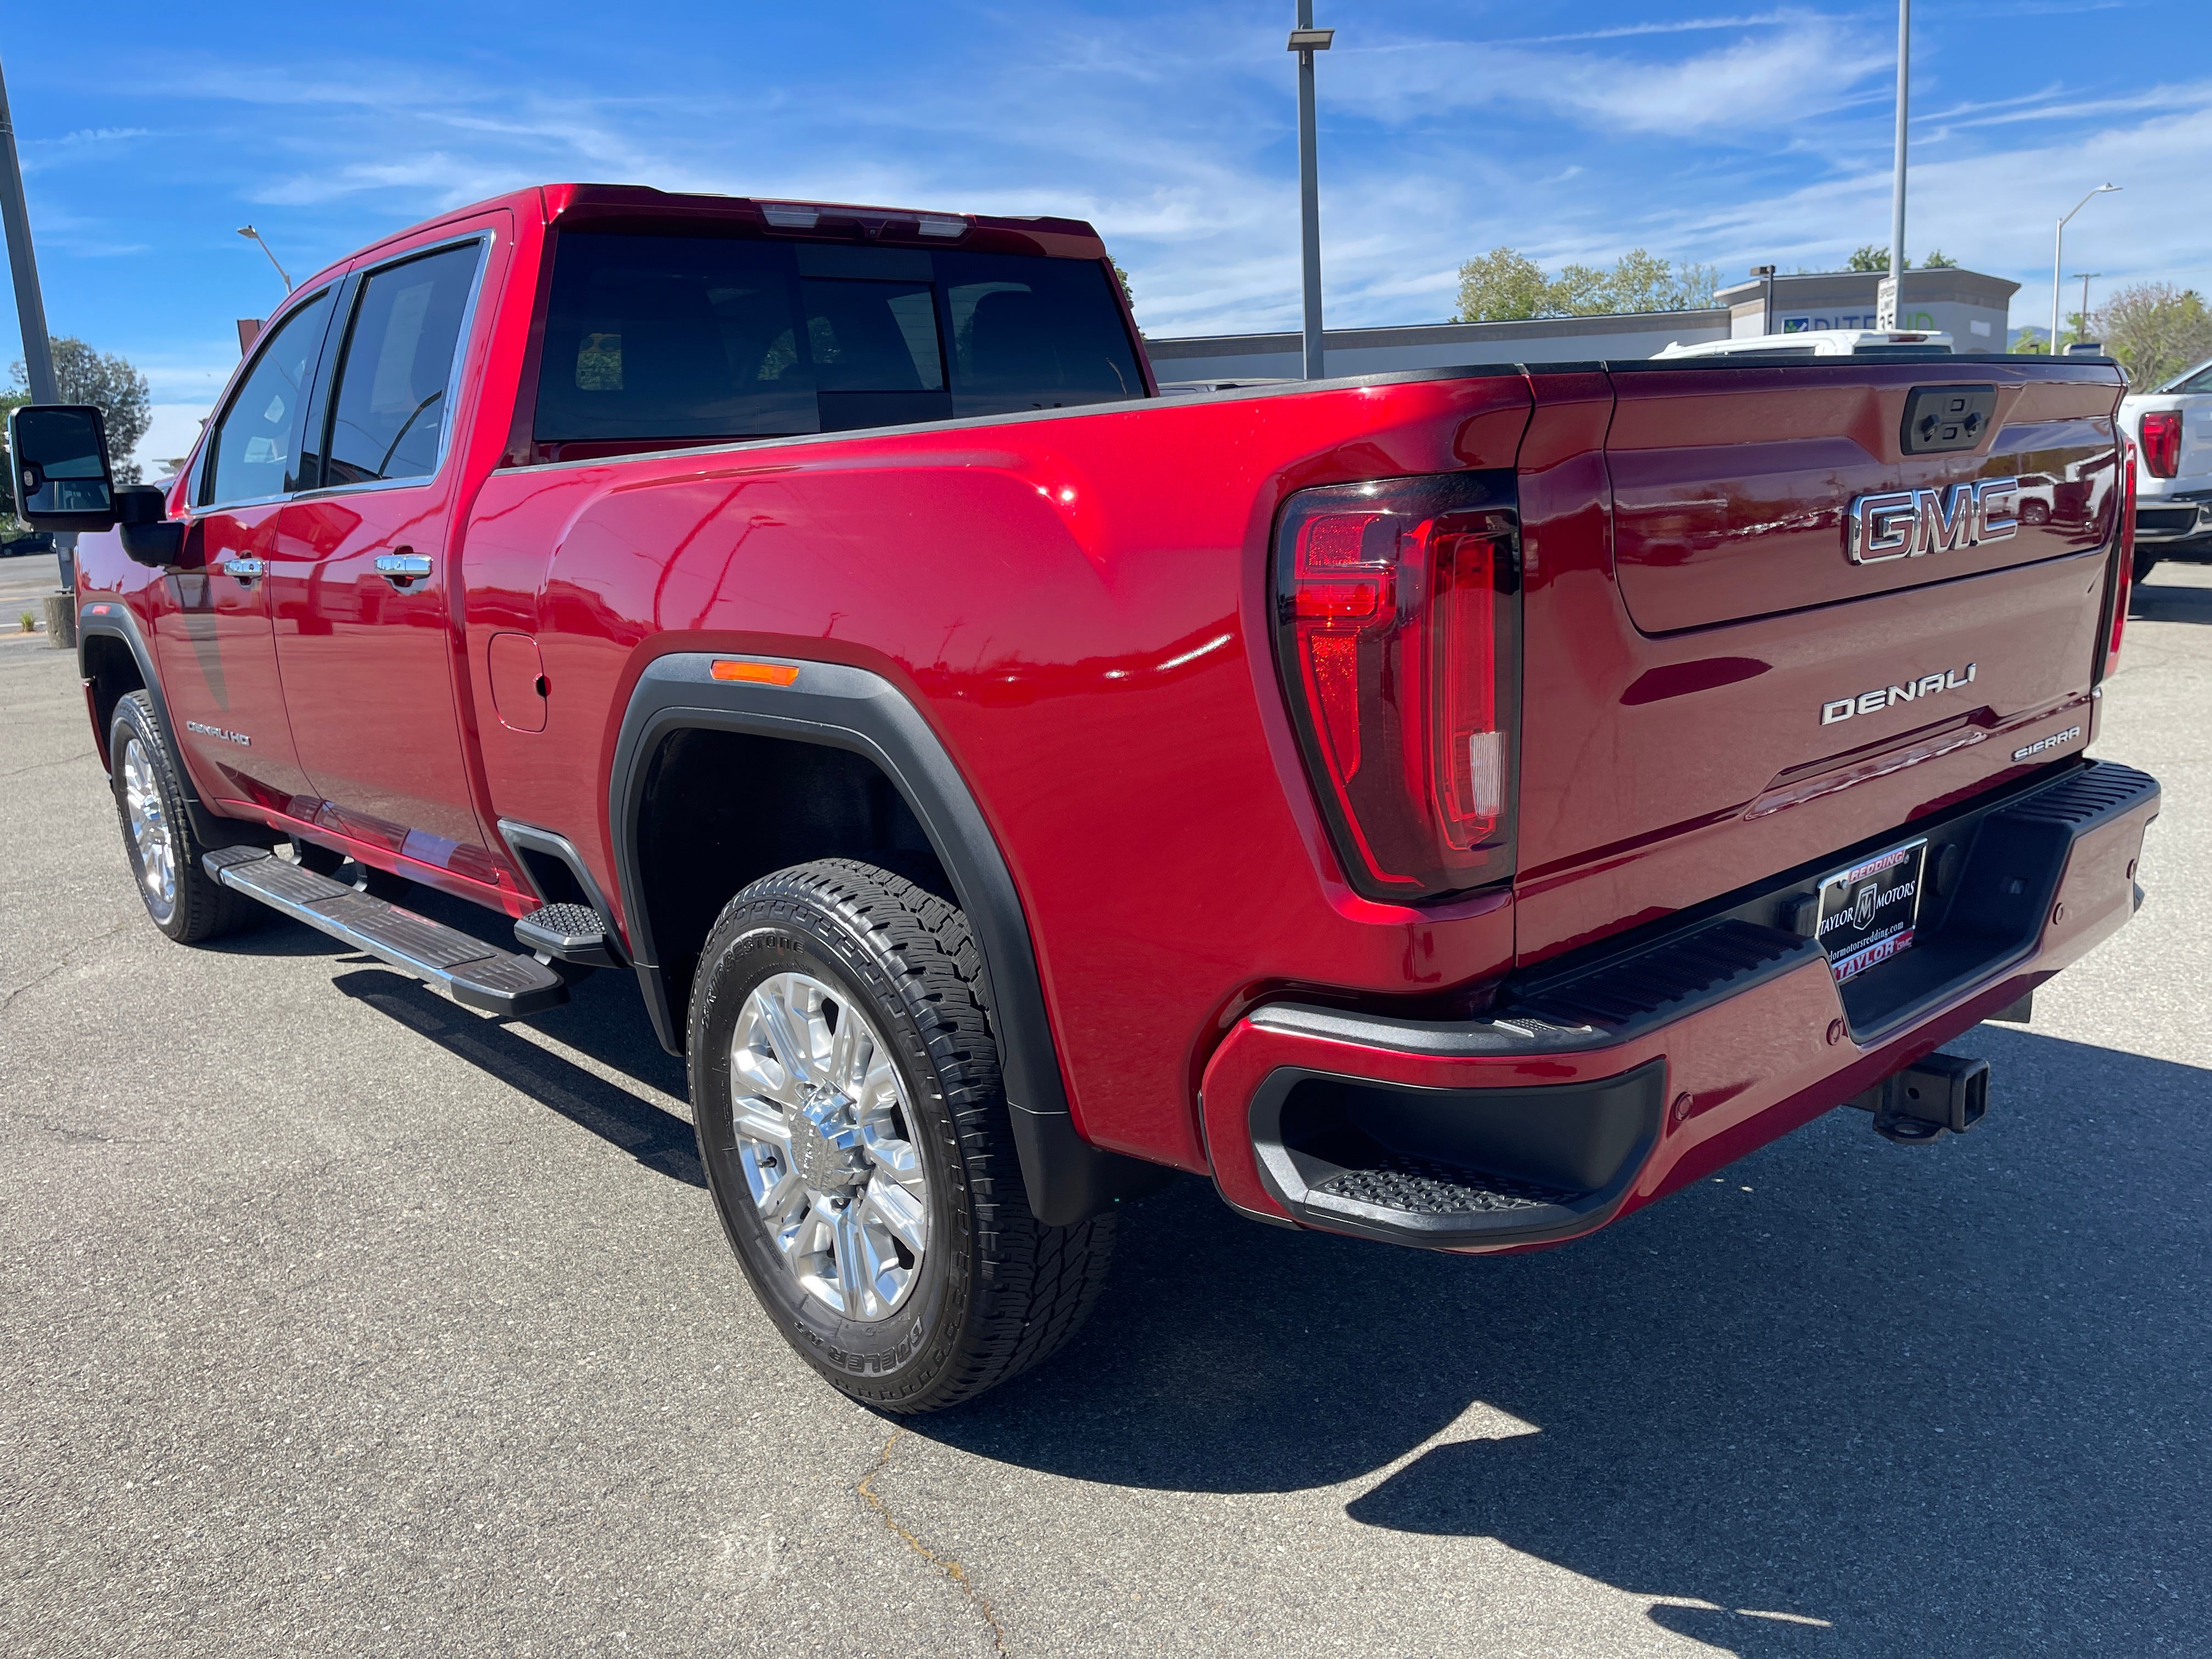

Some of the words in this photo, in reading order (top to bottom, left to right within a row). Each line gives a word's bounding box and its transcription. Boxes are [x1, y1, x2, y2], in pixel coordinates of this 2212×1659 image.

[1848, 476, 2019, 566] GMC
[1821, 662, 1977, 725] DENALI
[186, 720, 232, 741] DENALI
[229, 731, 252, 747] HD
[2011, 726, 2081, 762] SIERRA
[1849, 851, 1904, 881] REDDING
[1820, 907, 1854, 935] TAYLOR
[1876, 880, 1916, 910] MOTORS
[701, 932, 805, 1030] BRIDGESTONE
[1838, 940, 1895, 979] TAYLOR
[827, 1313, 924, 1373] DUELER
